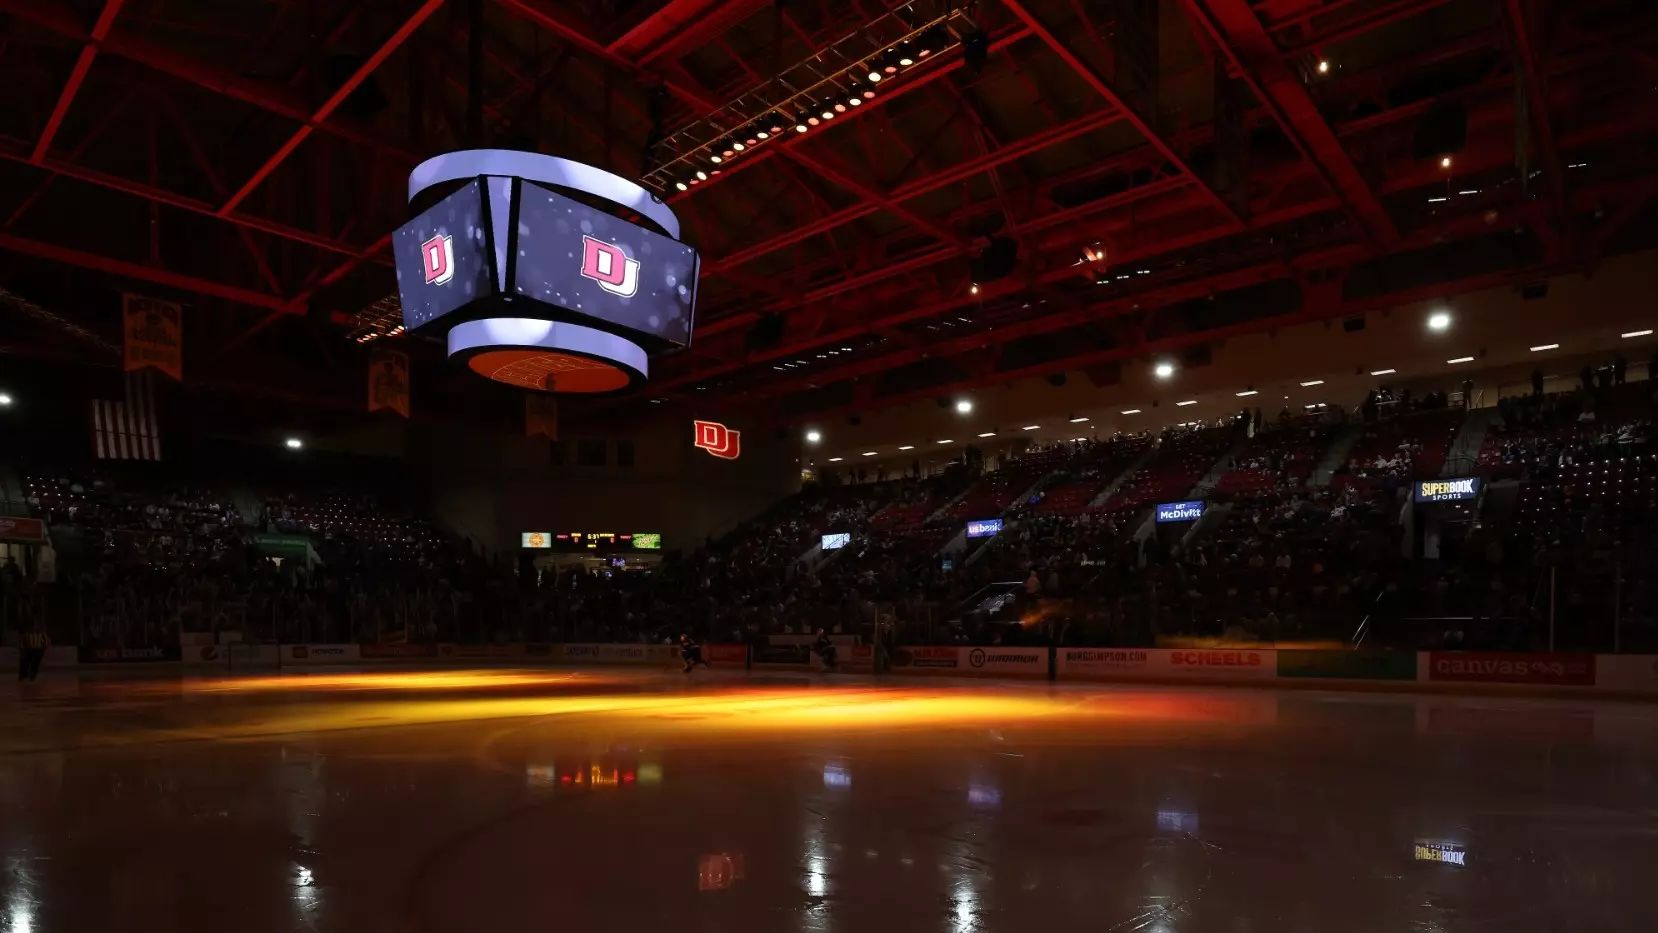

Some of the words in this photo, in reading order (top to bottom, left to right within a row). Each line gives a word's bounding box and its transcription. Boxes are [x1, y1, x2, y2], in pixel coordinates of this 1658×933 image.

[421, 234, 454, 286] DU
[581, 234, 640, 298] DU
[694, 420, 740, 459] DU
[1422, 479, 1474, 497] SUPERBOOK
[1160, 509, 1201, 519] McDivitt
[1170, 653, 1262, 666] SCHEELS
[1437, 657, 1529, 675] canvas
